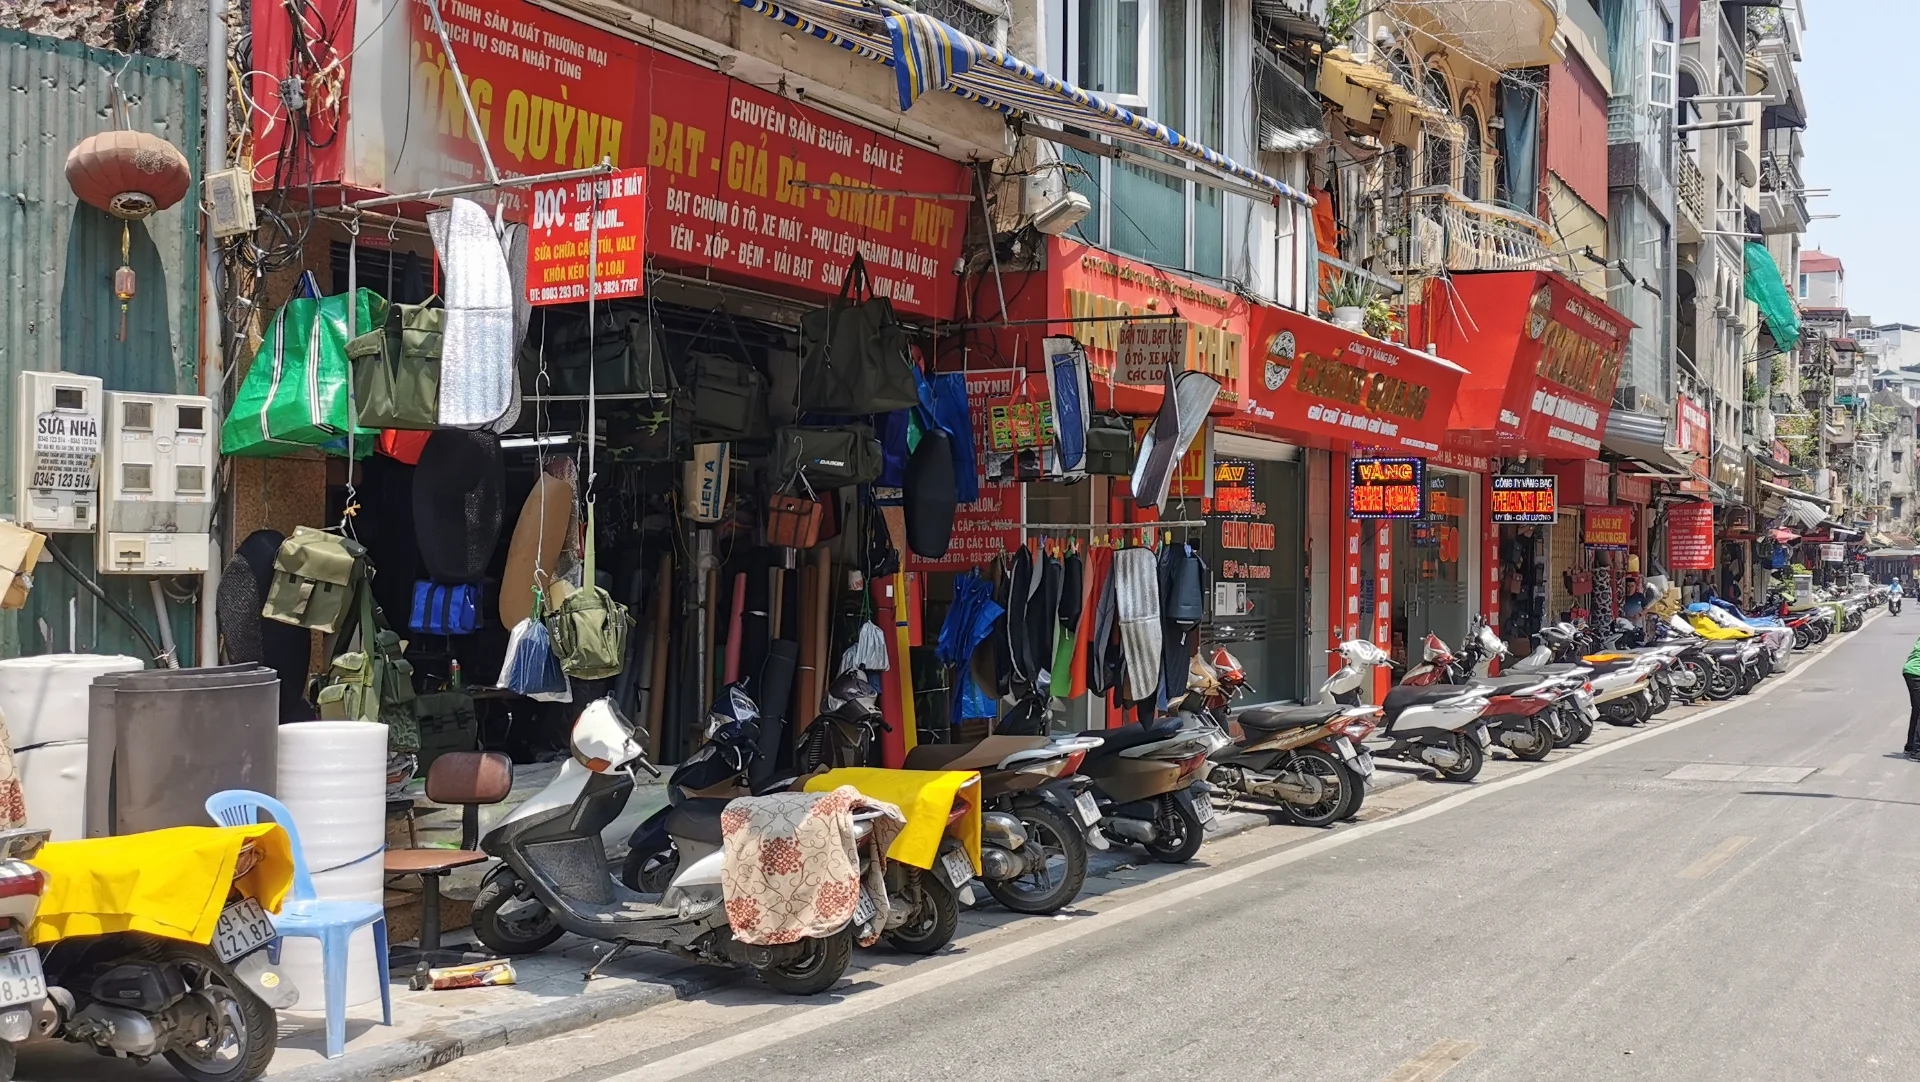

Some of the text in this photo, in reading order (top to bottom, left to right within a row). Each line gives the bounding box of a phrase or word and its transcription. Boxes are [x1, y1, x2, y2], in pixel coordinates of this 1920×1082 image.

[451, 0, 481, 24] TNHH
[483, 10, 509, 33] SẢN
[511, 22, 540, 43] XUẤT
[543, 31, 585, 58] THƯƠNG
[587, 47, 607, 67] MẠI
[473, 31, 488, 53] VỤ
[490, 37, 519, 60] SOFA
[522, 47, 552, 71] NHẬT
[554, 57, 582, 81] TÙNG
[504, 85, 623, 170] QUỲNH
[730, 96, 904, 175] CHUYÊN BÁN BUÔN BÁN LẺ
[647, 113, 706, 184] BẠT
[727, 132, 769, 198] GIẢ
[775, 155, 807, 208] DA
[533, 187, 567, 237] BỌC
[576, 179, 592, 202] YÊN
[612, 179, 623, 198] XE
[624, 172, 643, 196] MÁY
[574, 206, 624, 232] GHẾ ALON...
[666, 187, 939, 279] BẠT CHÙM Ô TÔ, XE MÁY PHỤ LIỆU NGÀNH DA VẢI BẠT
[534, 236, 637, 261] SỬA CHỮA CẶ TÚI, VALY
[544, 264, 566, 283] KHÓA
[568, 262, 585, 280] KÉO
[606, 260, 625, 278] LOẠI
[670, 223, 694, 252] YÊN
[703, 230, 730, 260] XỐP
[738, 240, 765, 269] ĐỆM
[774, 246, 792, 276] VẢI
[793, 256, 814, 282] BẠT
[821, 259, 842, 287] SÀN
[873, 275, 892, 299] KIM
[530, 289, 540, 301] ĐT:
[542, 287, 558, 301] 0903
[559, 286, 571, 298] 293
[572, 284, 585, 297] 074
[603, 280, 620, 294] 3824
[621, 278, 638, 292] 7797
[1152, 329, 1167, 348] BẠT
[1194, 319, 1242, 380] PHÁT
[1348, 340, 1365, 356] CÔNG
[1148, 352, 1160, 365] XE
[966, 377, 1011, 394] QUỲNH
[1127, 368, 1146, 381] CÁC
[70, 418, 97, 437] NHÀ
[33, 472, 90, 488] 0345 123 514
[1359, 461, 1412, 480] VÀNG
[1495, 477, 1512, 488] CÔNG
[1521, 477, 1539, 488] VÀNG
[1540, 478, 1552, 489] BẠC
[1493, 487, 1554, 512] THANH HÀ
[1592, 515, 1611, 529] BÁNH
[966, 534, 983, 550] CÁC
[1222, 517, 1275, 552] CHÍNH QUANG
[1586, 531, 1627, 544] HAMBURGER
[1239, 563, 1249, 578] HÀ
[219, 918, 272, 957] 421.82
